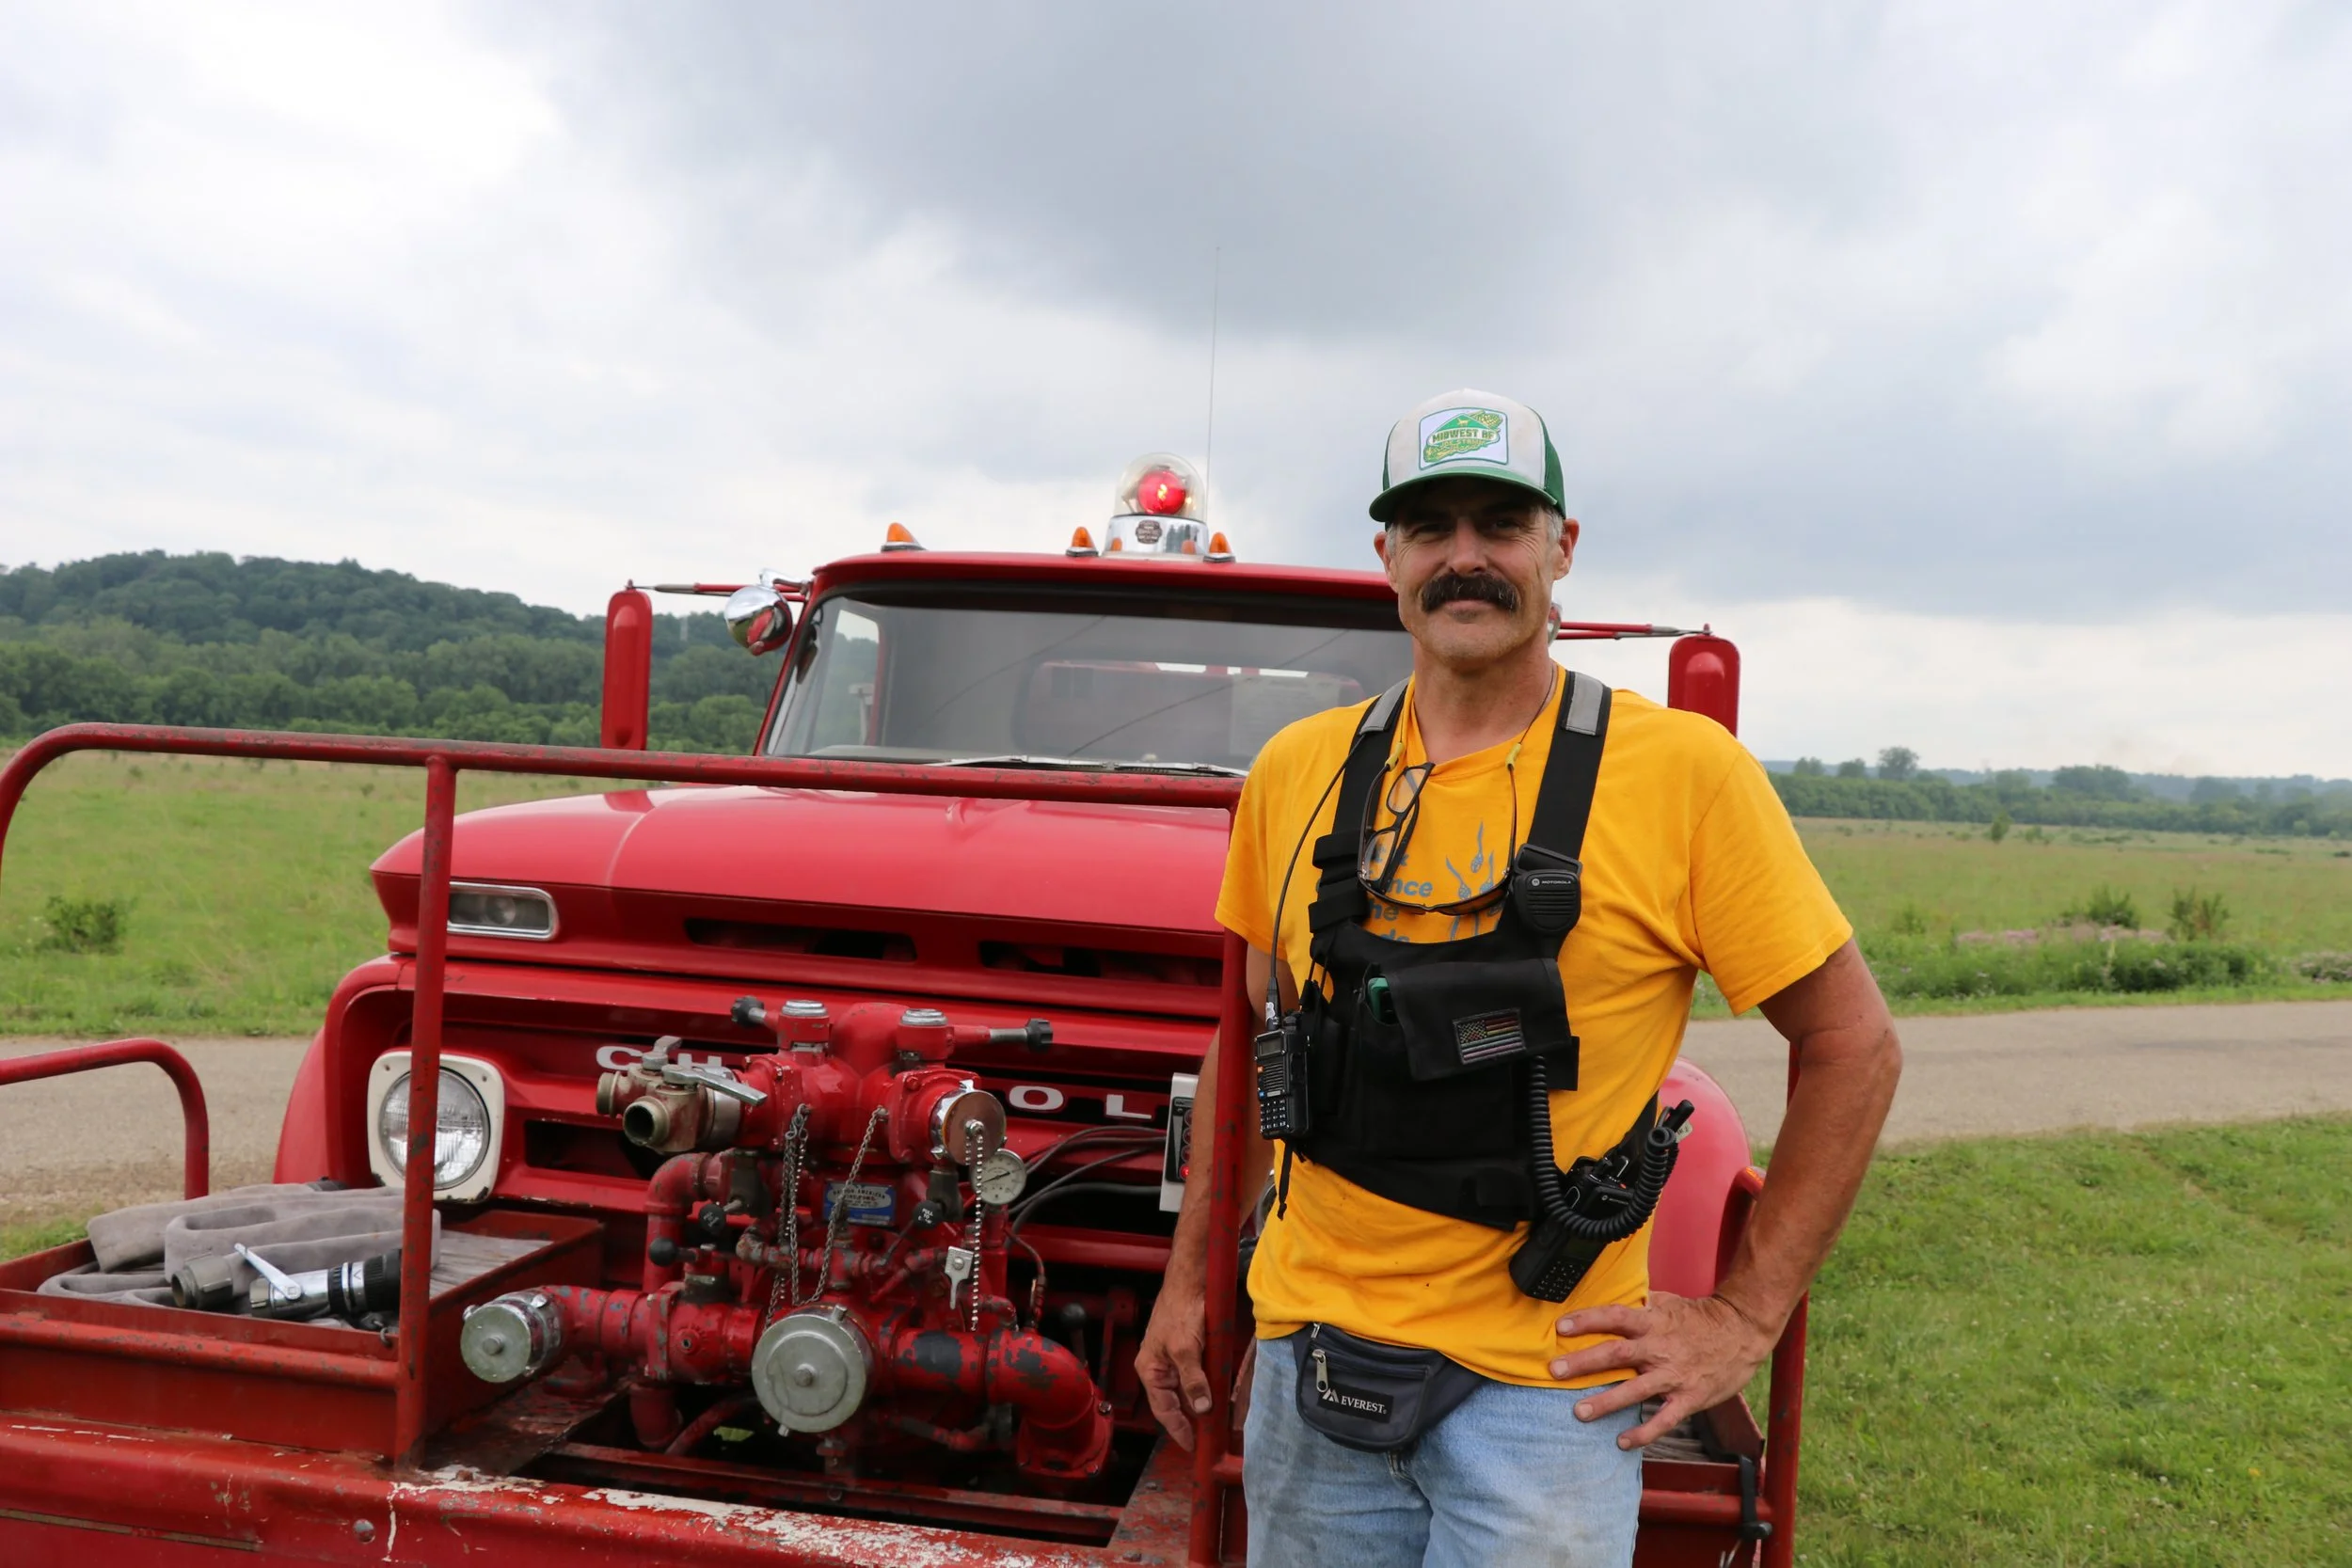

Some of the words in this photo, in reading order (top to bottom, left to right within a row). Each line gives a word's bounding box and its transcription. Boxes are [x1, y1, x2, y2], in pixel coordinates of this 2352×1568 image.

[1432, 428, 1479, 443] MIDWEST
[1388, 878, 1433, 897] nce
[1369, 899, 1399, 921] he
[1341, 1395, 1385, 1414] EVEREST
